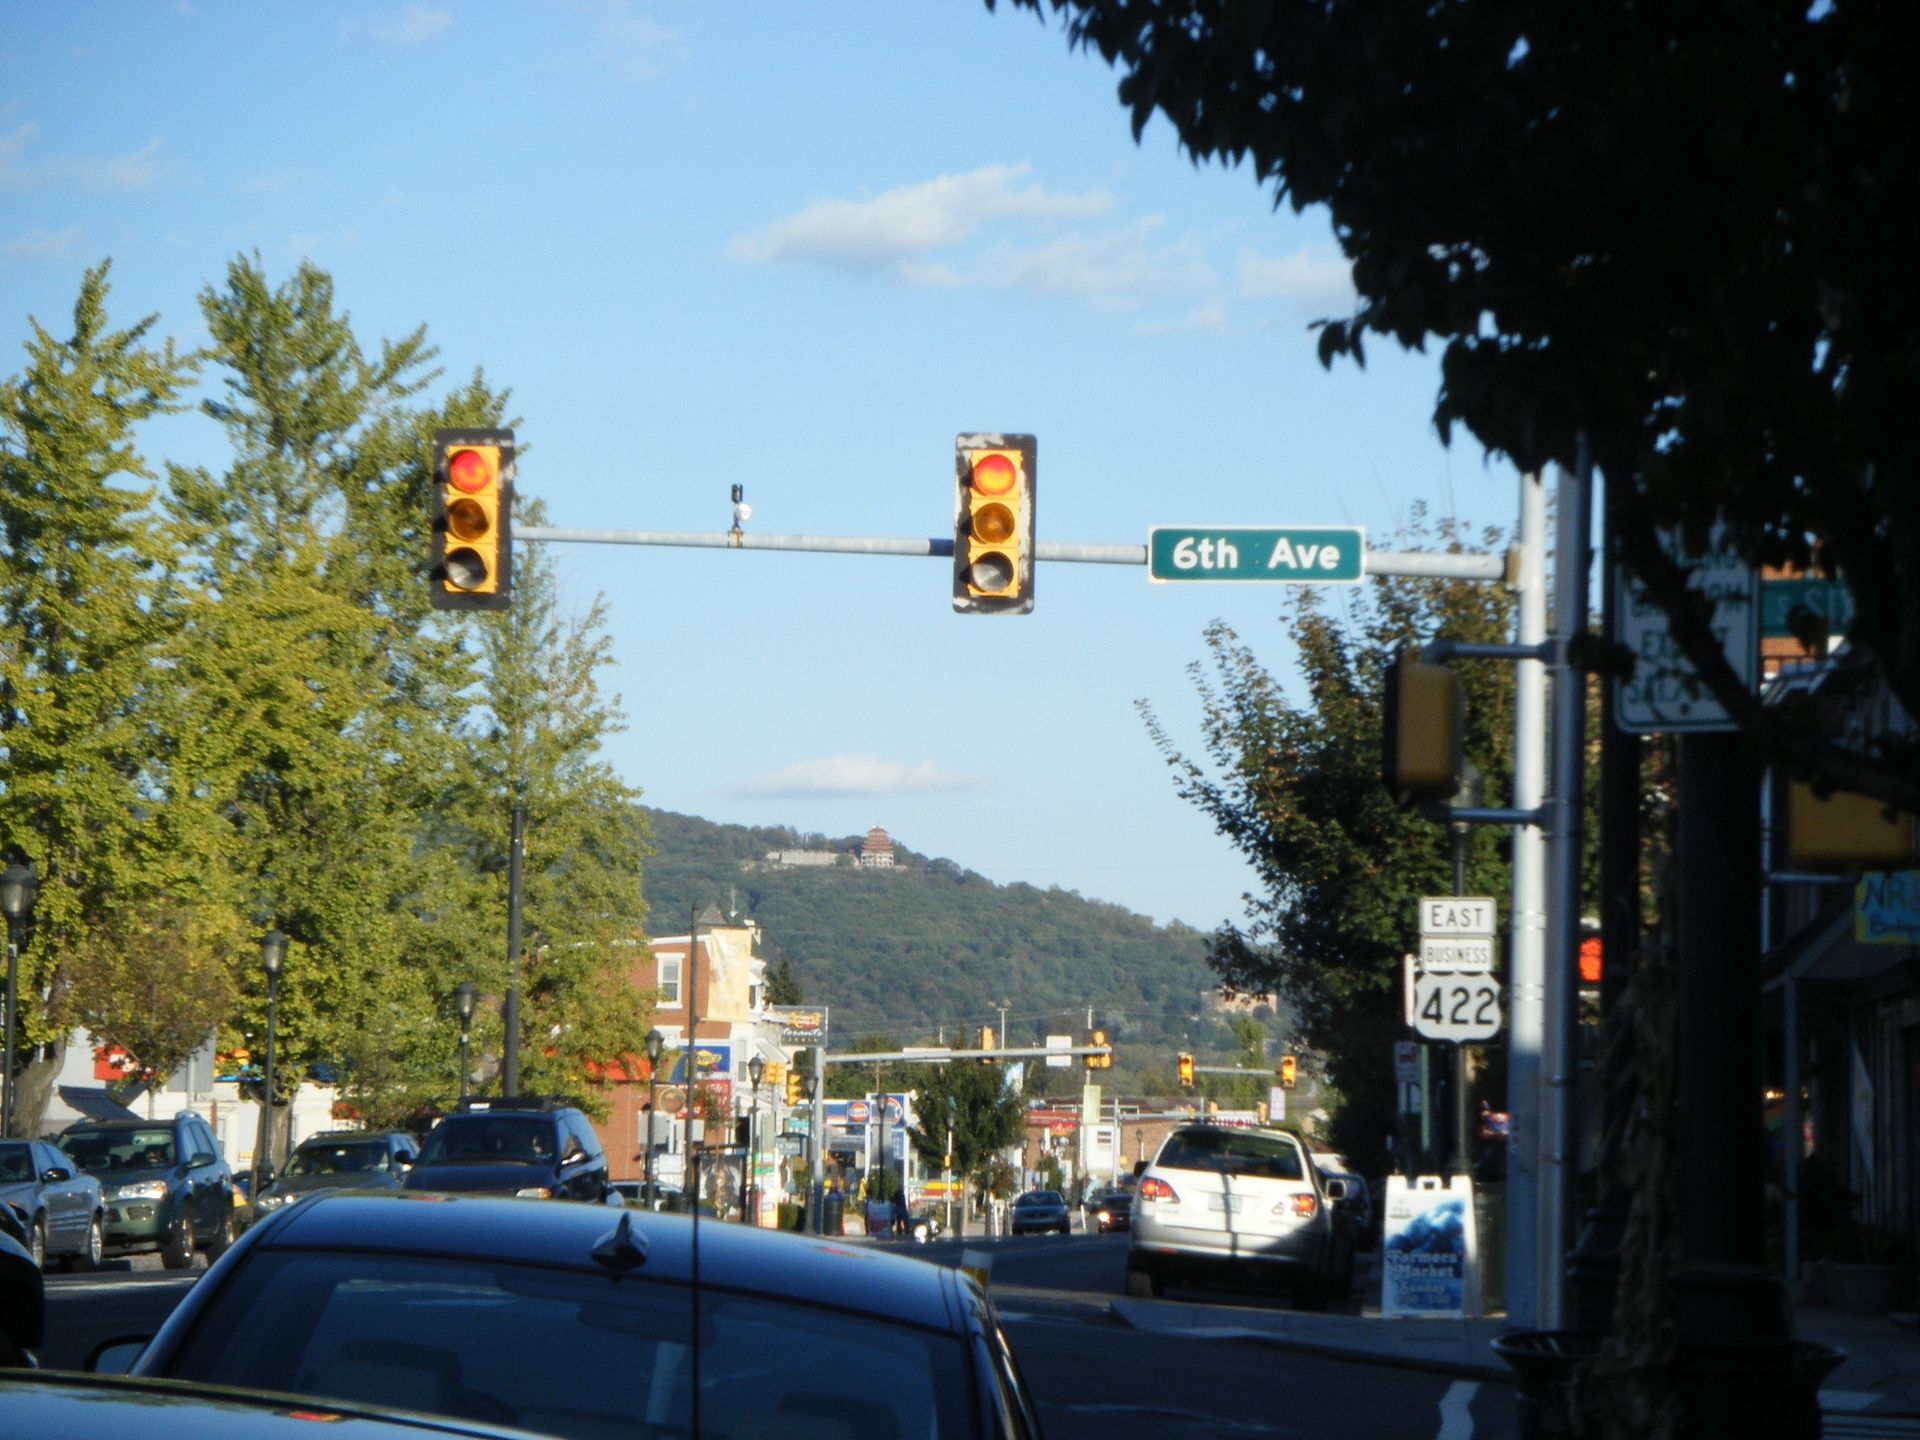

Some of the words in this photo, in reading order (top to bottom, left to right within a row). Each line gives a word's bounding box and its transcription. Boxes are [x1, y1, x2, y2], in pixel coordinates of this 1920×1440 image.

[1173, 537, 1238, 570] 6th
[1267, 537, 1341, 570] Ave
[1431, 904, 1484, 928] EAST
[1426, 946, 1489, 964] BUSINESS
[1421, 986, 1496, 1026] 422
